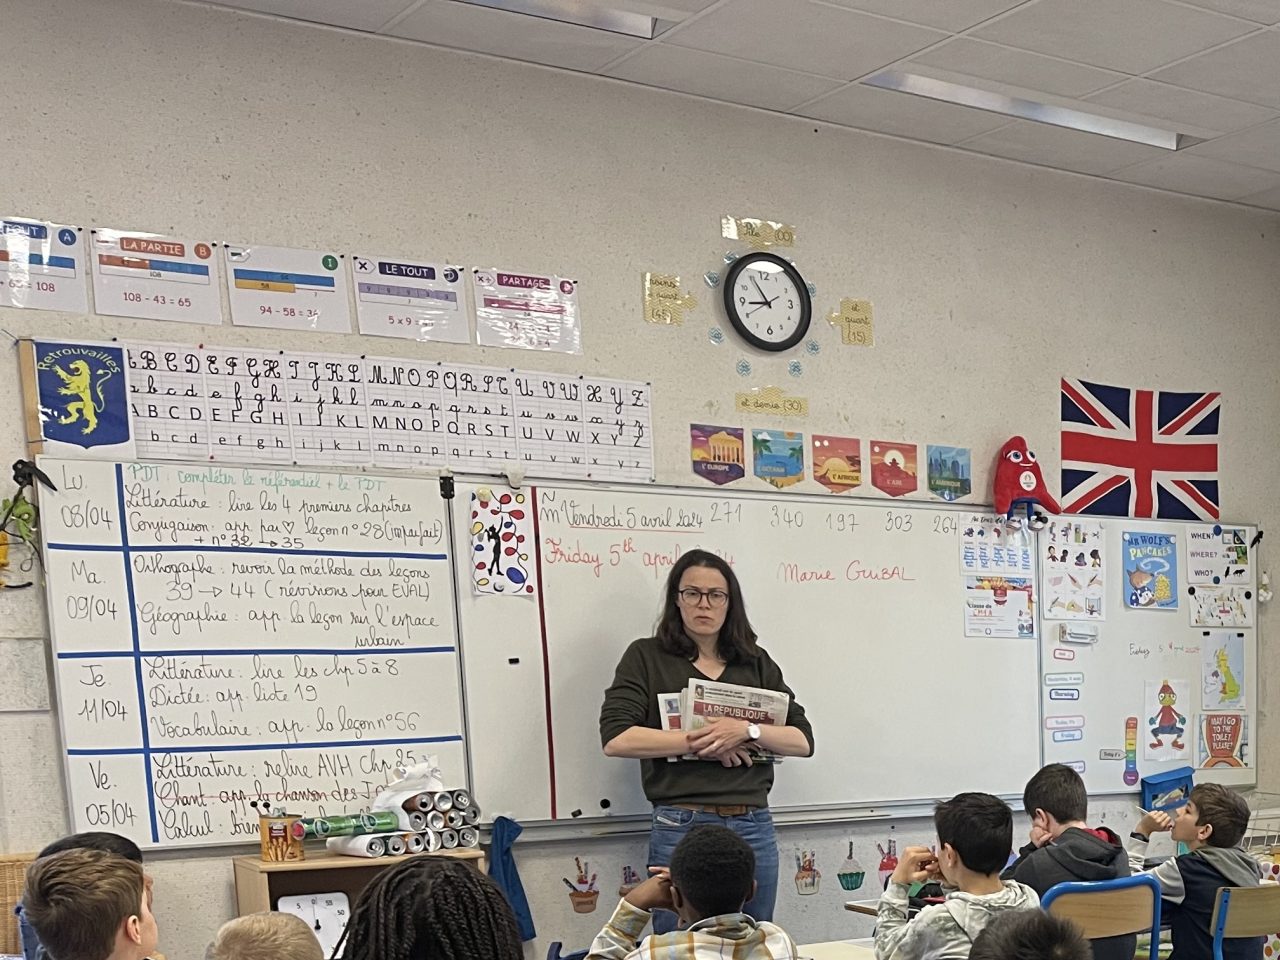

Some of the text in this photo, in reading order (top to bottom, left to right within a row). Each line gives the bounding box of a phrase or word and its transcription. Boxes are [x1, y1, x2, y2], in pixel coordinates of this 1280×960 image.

[123, 240, 183, 256] LA PARTIE
[385, 265, 430, 278] LE TOUT
[502, 276, 546, 289] PARTAGE
[758, 271, 770, 281] 12
[36, 281, 55, 292] 108
[123, 292, 192, 307] 108 43 65
[259, 306, 296, 317] 94 58
[37, 347, 121, 374] Retrouvailles
[782, 399, 802, 412] (30)
[125, 483, 412, 524] Littérature lire les 4 premiers chapitres
[560, 498, 703, 529] Vendredi 5 avril 2024
[710, 501, 742, 524] 271
[61, 500, 113, 531] 08/04
[770, 504, 804, 528] 340
[825, 511, 860, 534] 197
[884, 511, 914, 533] 303
[932, 514, 959, 535] 264
[360, 521, 384, 539] 28
[1190, 532, 1215, 541] WHEN?
[281, 537, 304, 549] 35
[1190, 550, 1218, 559] WHERE?
[133, 553, 215, 583] Orthographe
[277, 557, 297, 575] la
[300, 557, 354, 576] méthode
[360, 560, 383, 577] des
[388, 557, 430, 583] leçons
[544, 537, 604, 578] Friday
[777, 560, 836, 584] Marie
[1194, 569, 1214, 577] WHO?
[166, 581, 255, 601] 39 44
[66, 595, 117, 622] 09/04
[137, 600, 439, 639] Géographie la leçon sur l'espace
[354, 625, 405, 648] urbain
[144, 655, 235, 679] Littérature
[250, 654, 285, 680] lire
[293, 655, 318, 678] les
[357, 658, 368, 675] 5
[385, 659, 399, 676] 8
[150, 681, 318, 707] Dictée liste 19
[78, 698, 128, 723] 11/04
[703, 703, 713, 713] LA
[150, 705, 421, 739] Vocabulaire la leçon 56
[1226, 716, 1236, 726] GO
[152, 752, 247, 780] Littérature
[263, 750, 313, 778] relire
[154, 780, 208, 809] Chant
[254, 780, 270, 802] la
[85, 798, 137, 828] 05/04
[158, 808, 214, 841] Calcul
